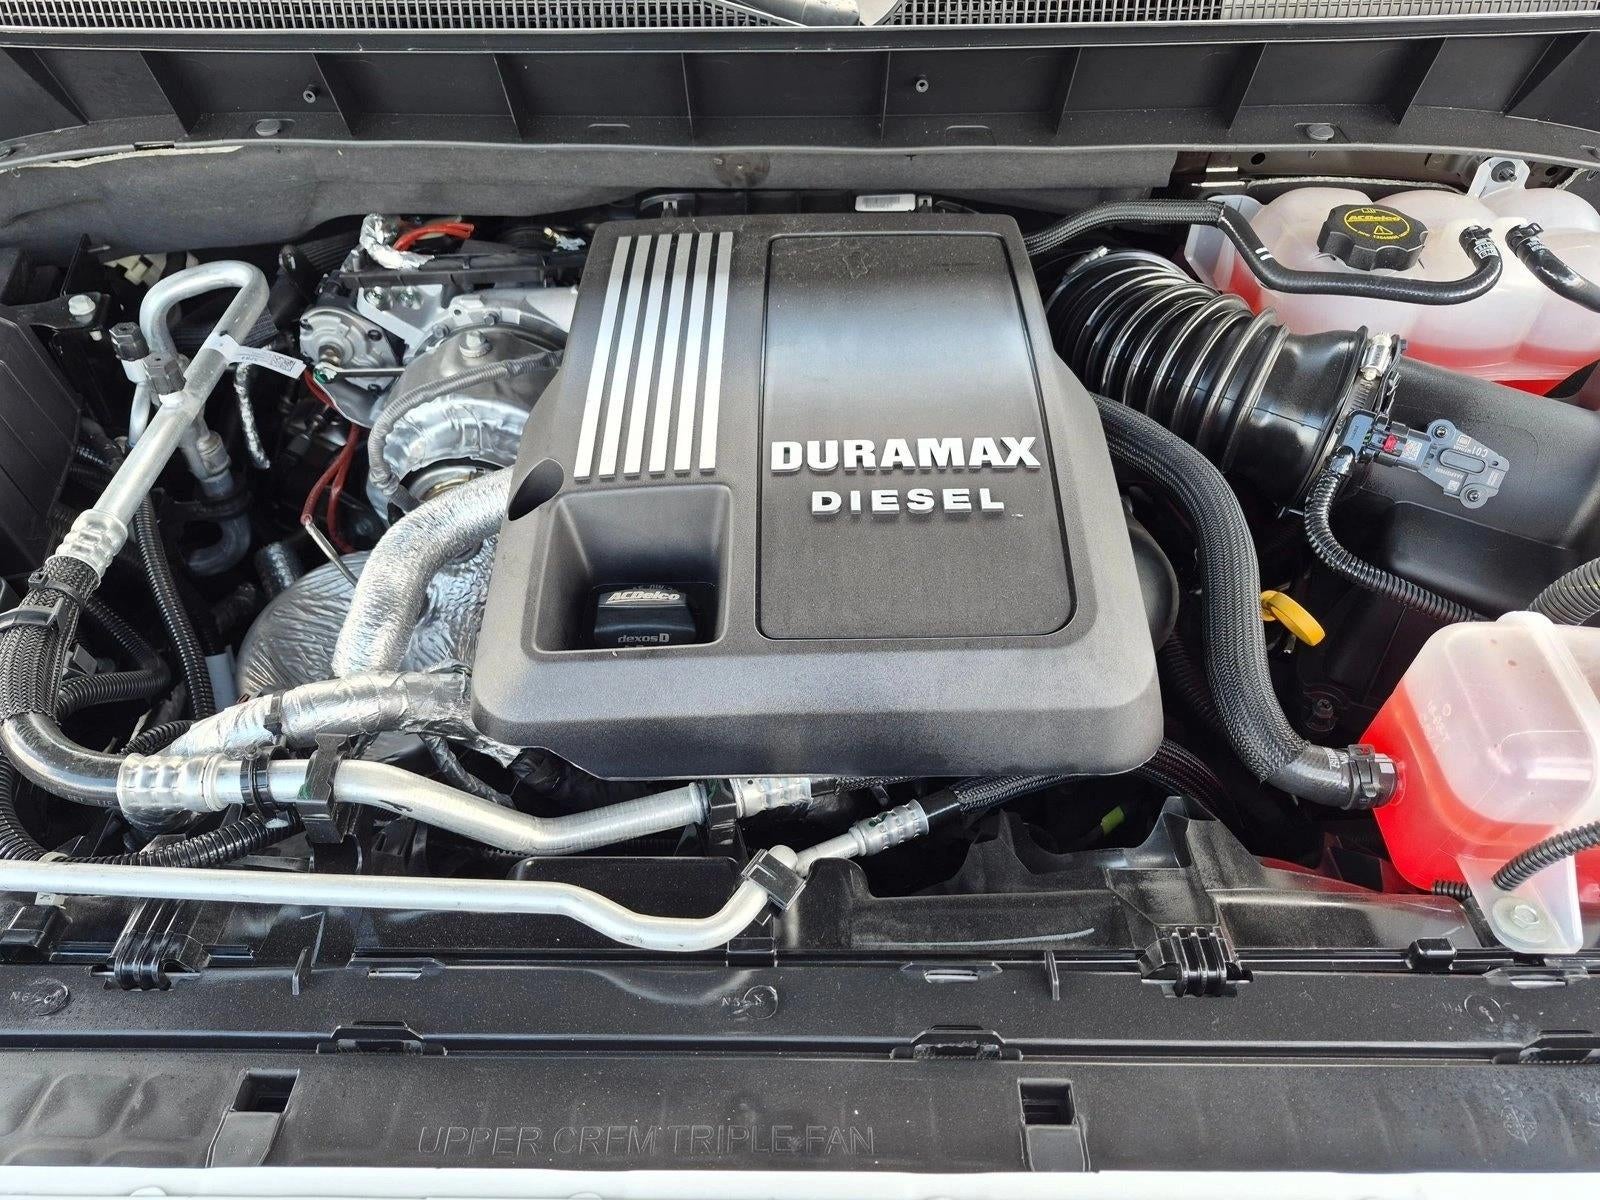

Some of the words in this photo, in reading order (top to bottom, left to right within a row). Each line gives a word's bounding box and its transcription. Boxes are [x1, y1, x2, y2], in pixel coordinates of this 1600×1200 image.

[771, 436, 1041, 472] DURAMAX
[812, 488, 1005, 514] DIESEL
[606, 591, 680, 604] ACDelco
[418, 1126, 543, 1155] UPPER
[667, 1124, 793, 1154] TRIPLE
[805, 1125, 874, 1155] FAN
